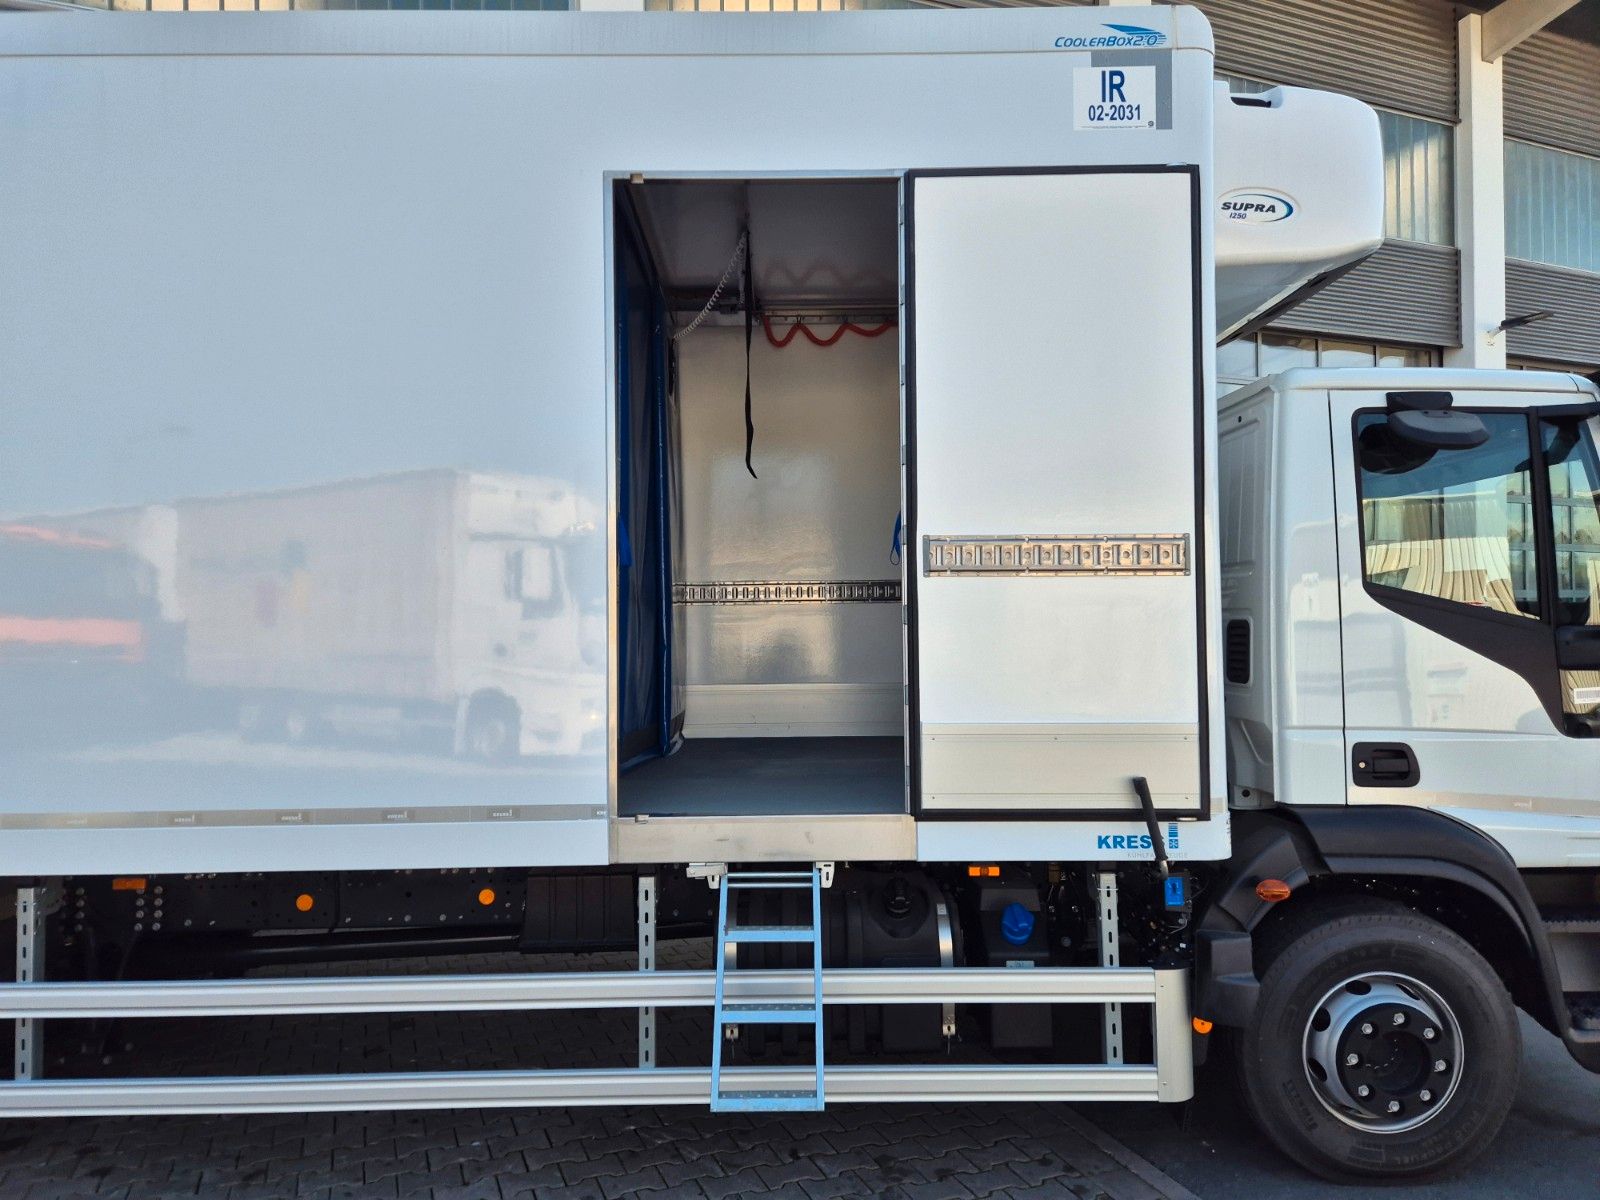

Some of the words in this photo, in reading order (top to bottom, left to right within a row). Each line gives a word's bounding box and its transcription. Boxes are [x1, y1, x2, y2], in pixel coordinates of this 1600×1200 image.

[1101, 70, 1126, 103] IR
[1088, 104, 1141, 121] 02-2031
[1221, 202, 1276, 213] SUPRA
[1097, 835, 1165, 849] KRES
